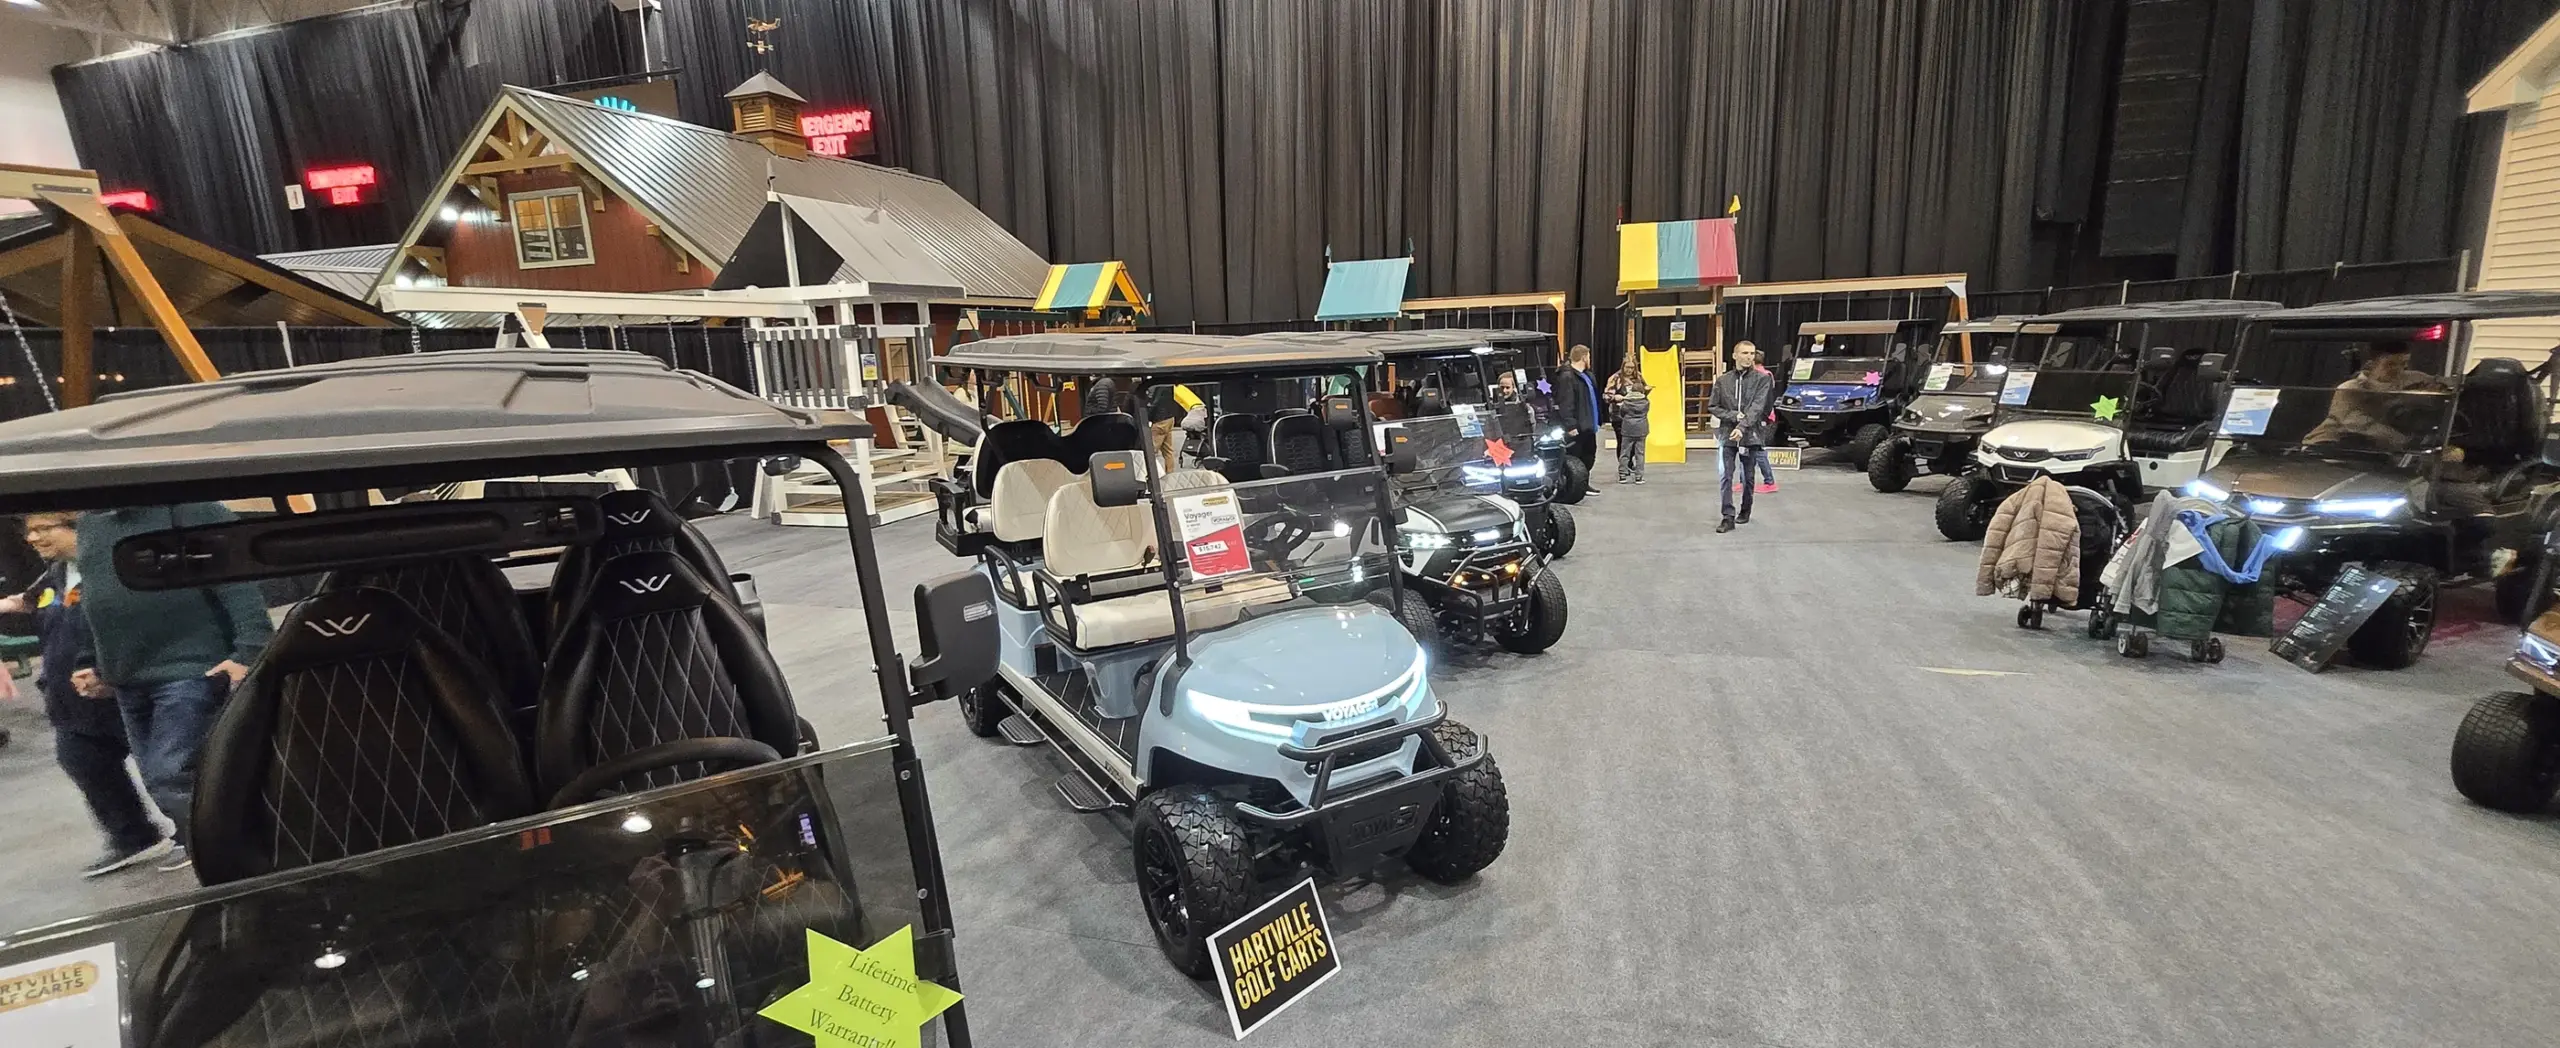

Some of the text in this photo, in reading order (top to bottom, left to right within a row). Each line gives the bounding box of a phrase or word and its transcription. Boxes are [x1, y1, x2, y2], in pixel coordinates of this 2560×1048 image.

[812, 134, 847, 155] EXIT
[1322, 697, 1380, 722] VOYAGER
[1229, 901, 1315, 977] HARTVILLE
[26, 978, 84, 999] CARTS
[848, 952, 917, 994] Lifetime
[1235, 928, 1327, 1010] GOLF CARTS
[836, 984, 898, 1025] Battery
